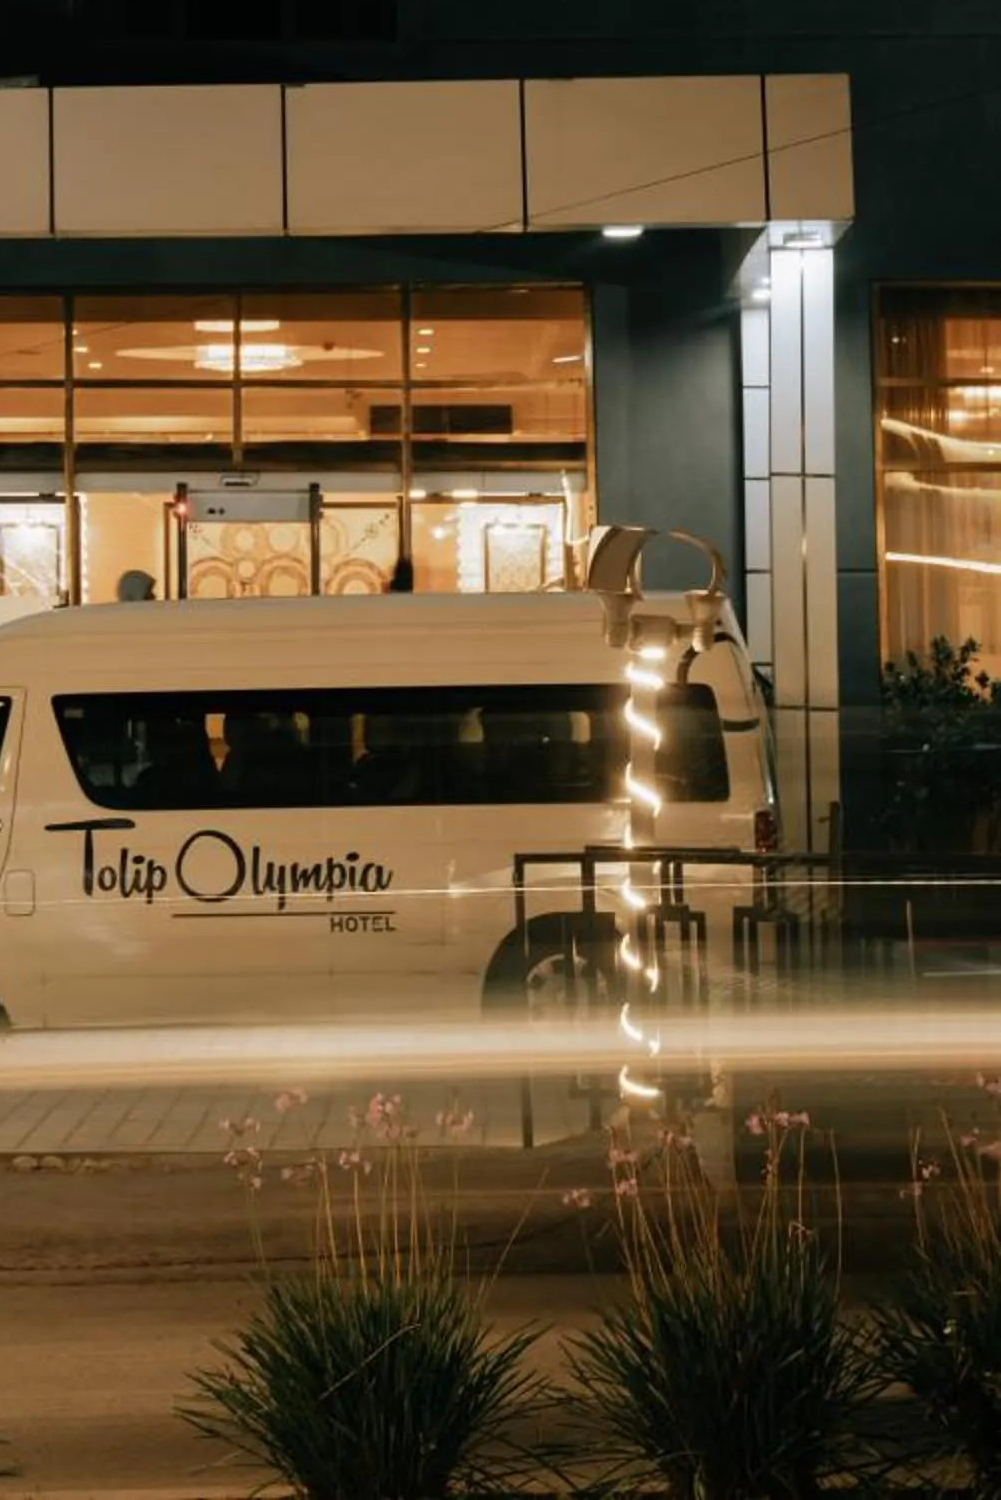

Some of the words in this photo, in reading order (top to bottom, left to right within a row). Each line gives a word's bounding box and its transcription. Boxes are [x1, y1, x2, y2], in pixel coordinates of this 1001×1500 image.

[44, 818, 168, 905] Tolip
[174, 829, 394, 911] Olympia
[329, 916, 397, 934] HOTEL
